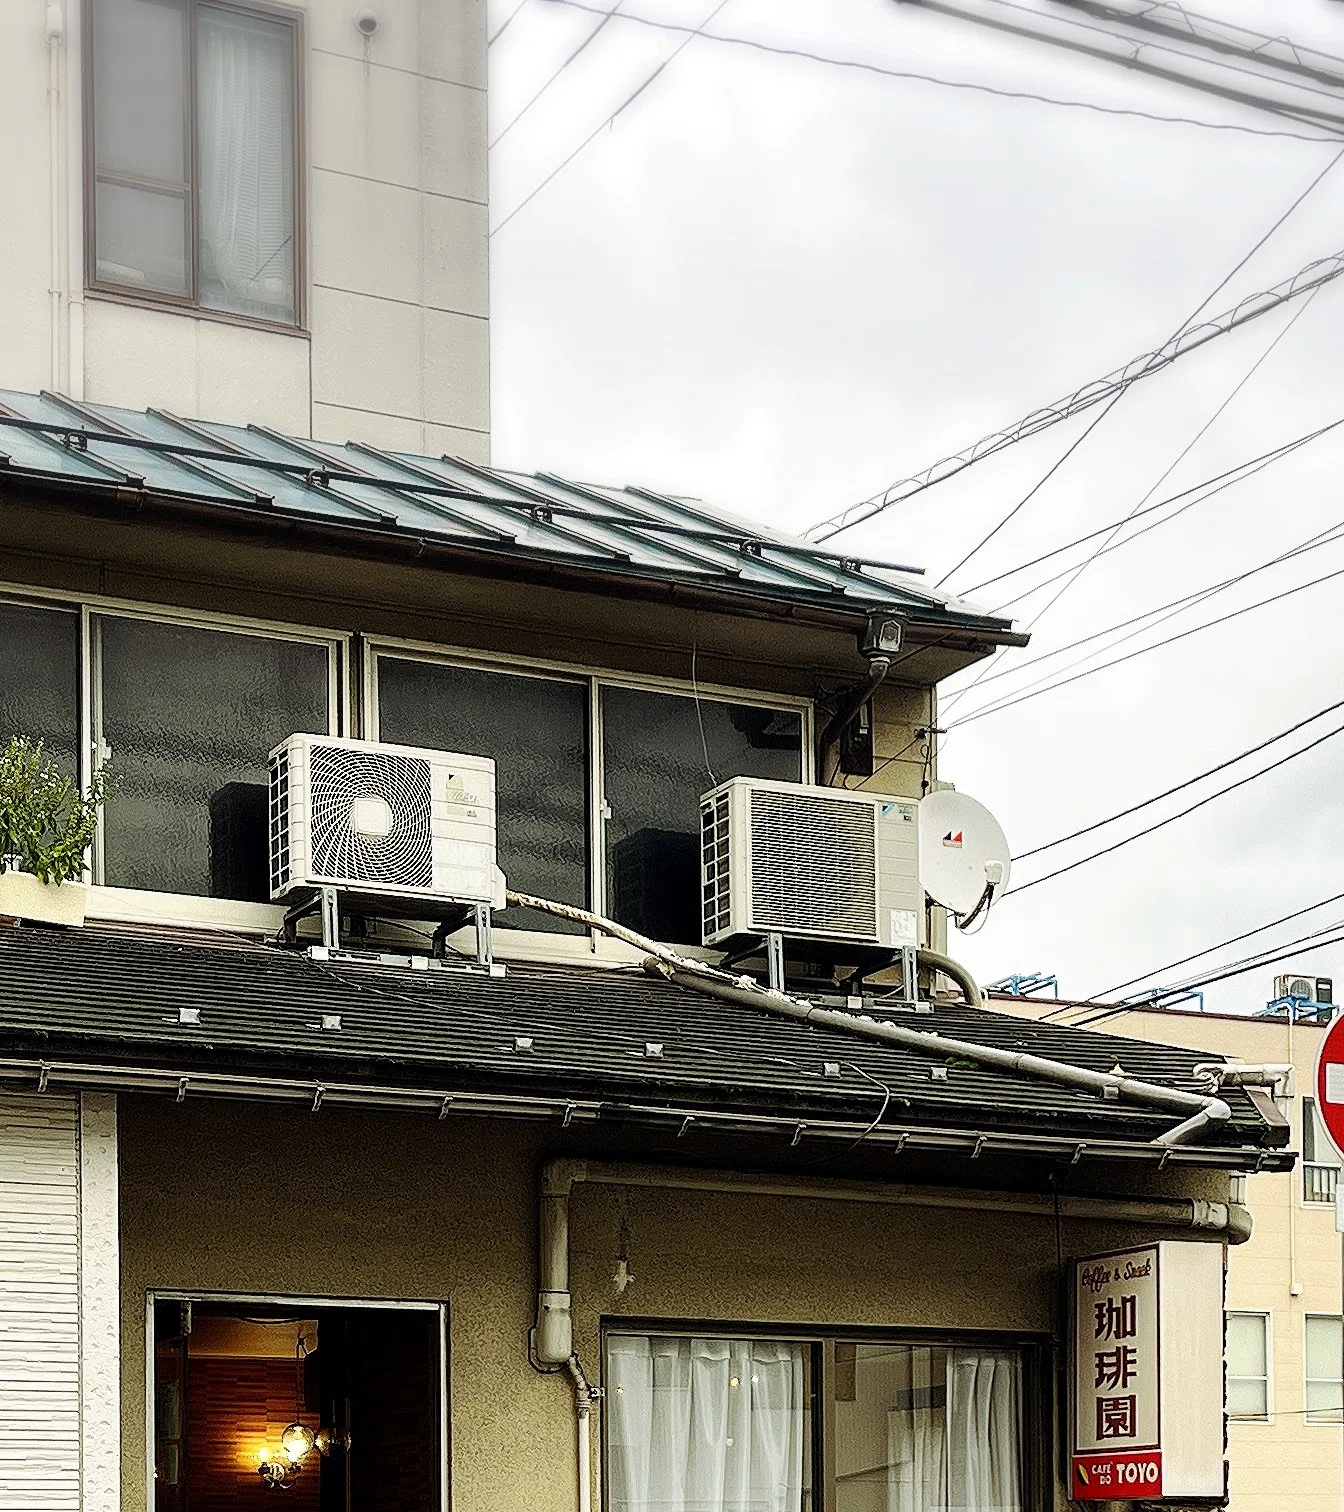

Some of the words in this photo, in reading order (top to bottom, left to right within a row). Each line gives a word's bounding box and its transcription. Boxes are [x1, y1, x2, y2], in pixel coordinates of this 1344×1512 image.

[1094, 1294, 1137, 1441] 珈琲園
[1099, 1475, 1112, 1485] DO
[1116, 1462, 1159, 1484] TOYO
